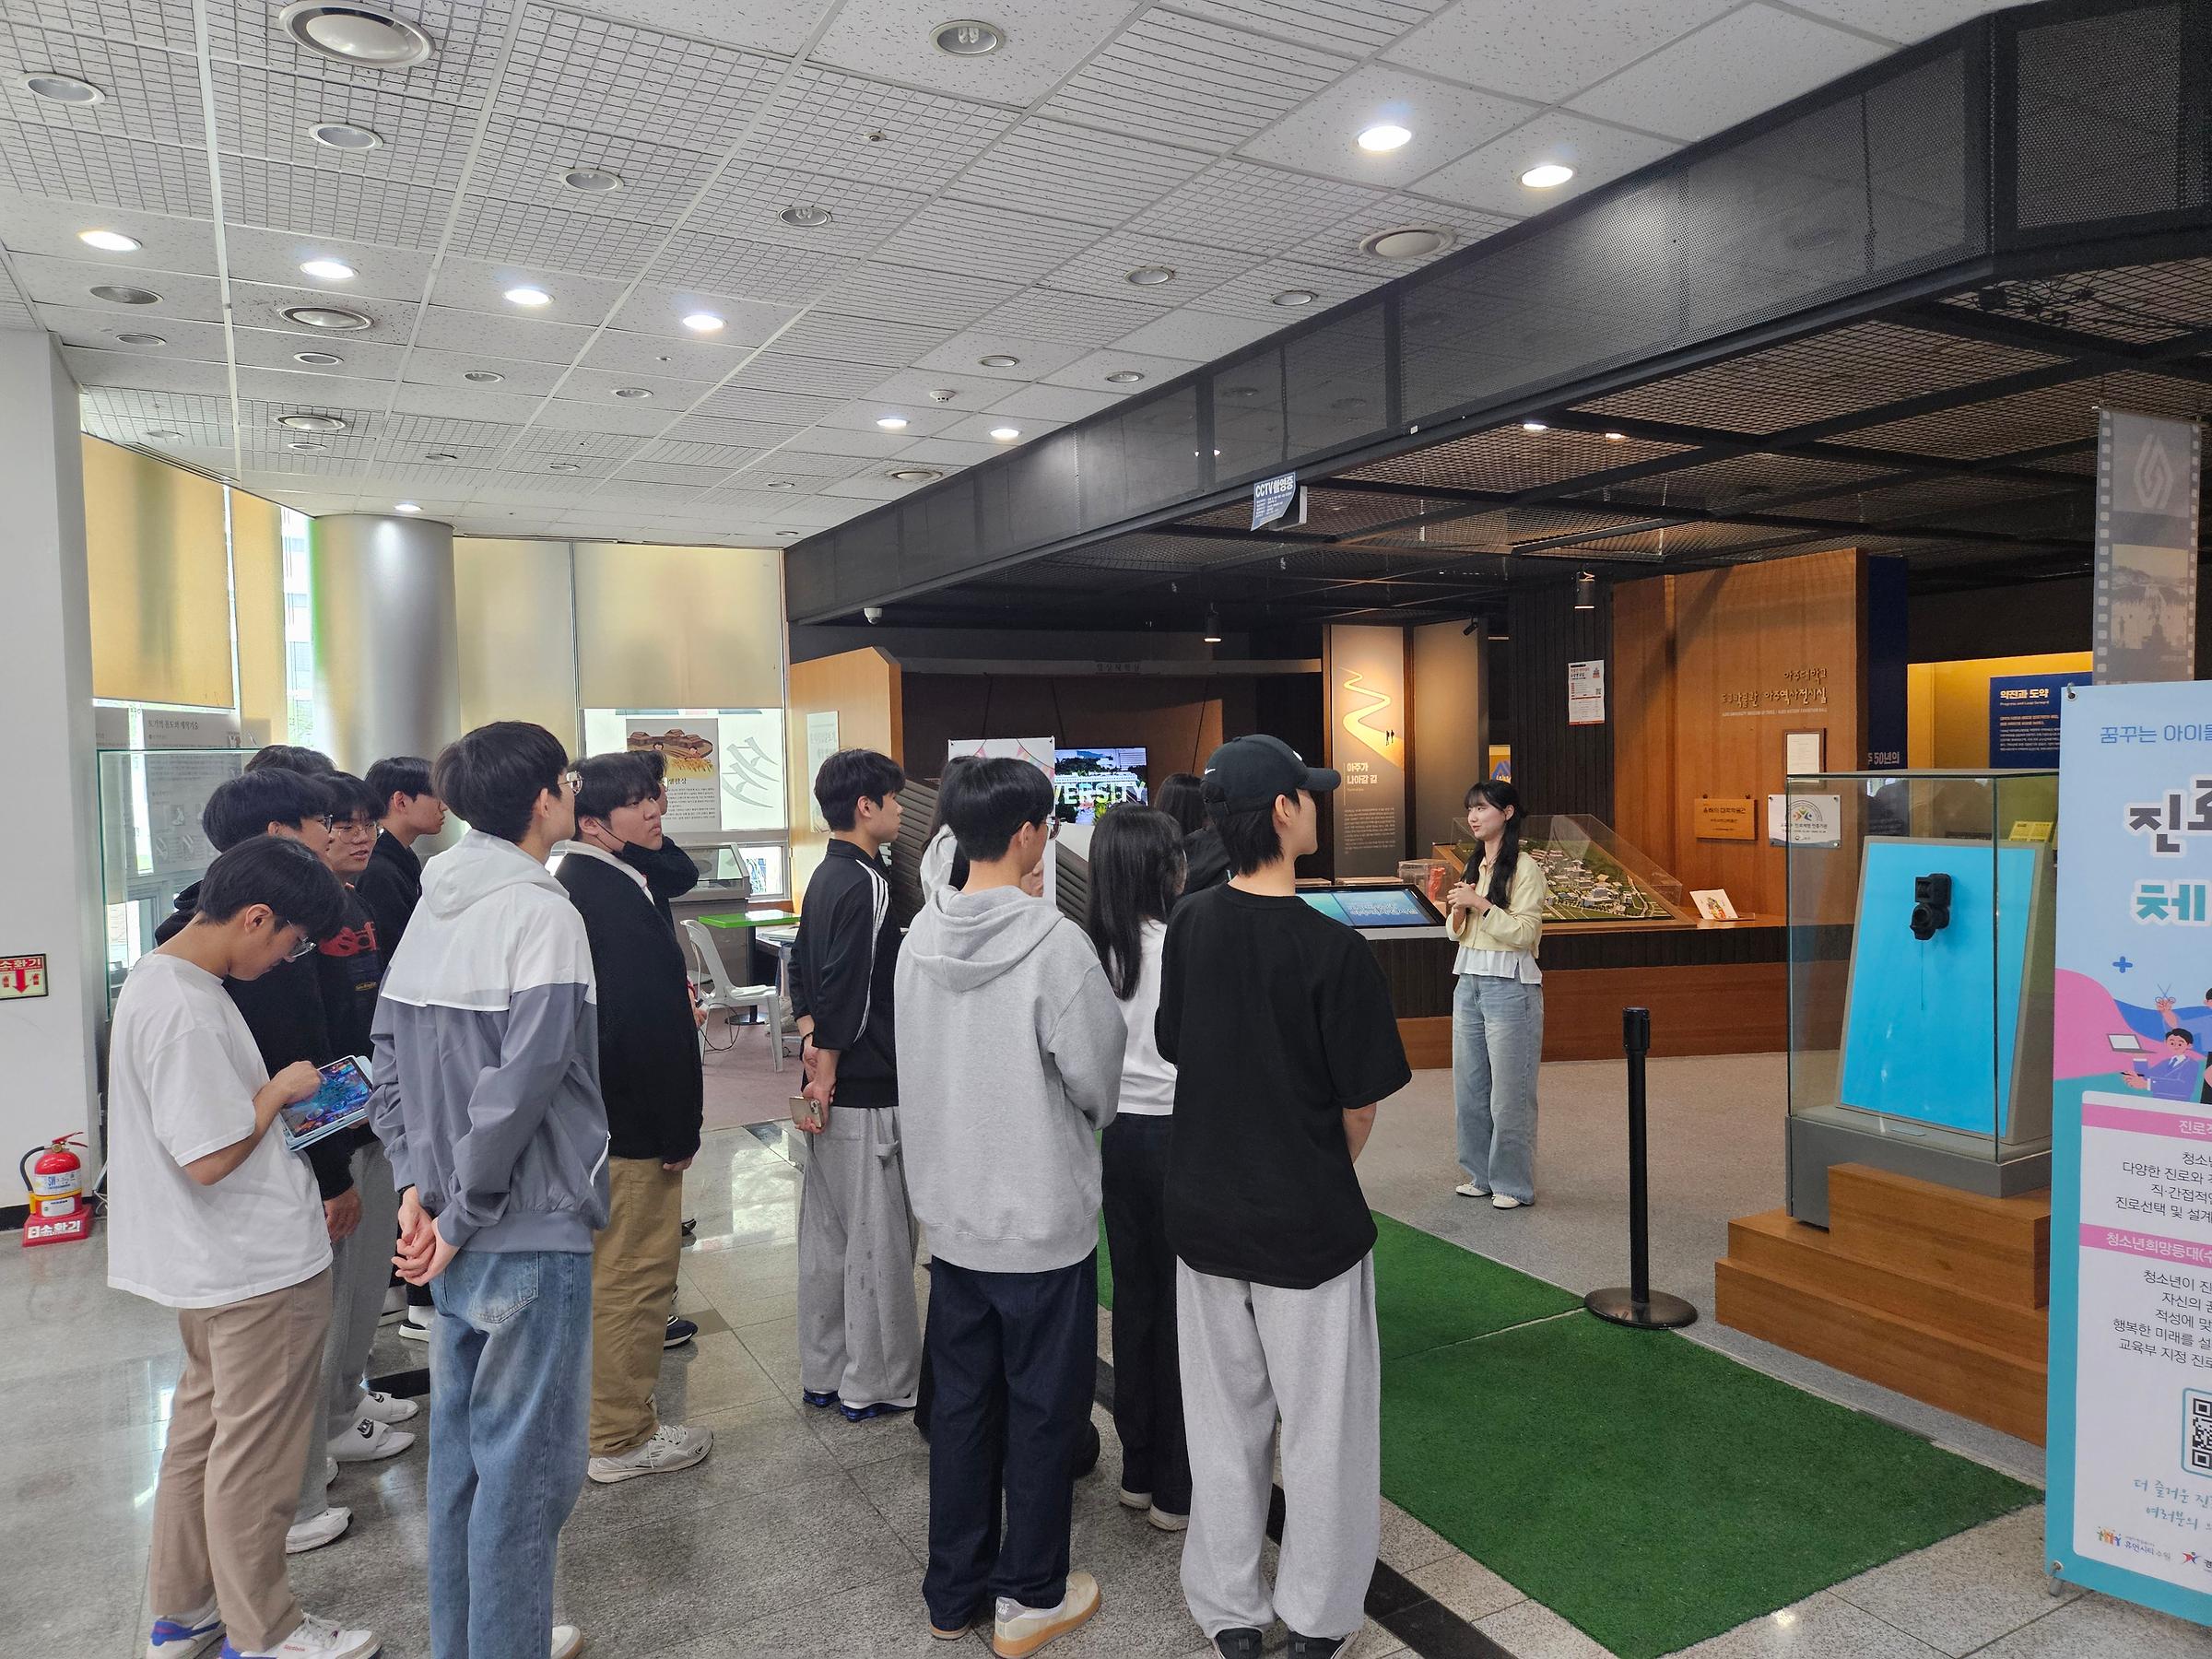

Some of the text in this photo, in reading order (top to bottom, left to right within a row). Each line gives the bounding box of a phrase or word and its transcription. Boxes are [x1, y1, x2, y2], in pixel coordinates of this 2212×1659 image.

[1784, 668, 1827, 684] 아주대학교
[2029, 688, 2050, 699] 도약
[2100, 724, 2157, 744] 꿈꾸는
[1347, 762, 1369, 772] 아주가
[1347, 775, 1378, 784] 나아갈 길
[0, 959, 41, 971] 소화기
[2123, 1161, 2160, 1179] 다양한
[2164, 1168, 2204, 1185] 진로와
[2115, 1196, 2166, 1216] 진로선택
[2171, 1206, 2183, 1219] 및
[40, 1220, 81, 1236] 소화기
[2144, 1269, 2194, 1291] 청소년이
[2161, 1291, 2202, 1311] 자신의
[2156, 1309, 2194, 1328] 적성에
[2113, 1317, 2151, 1337] 행복한
[2156, 1327, 2194, 1347] 미래를
[2119, 1338, 2157, 1357] 교육부
[2161, 1347, 2187, 1365] 지정
[2134, 1479, 2148, 1491] 더
[2154, 1480, 2189, 1504] 즐거운
[2146, 1506, 2198, 1531] 여러분의
